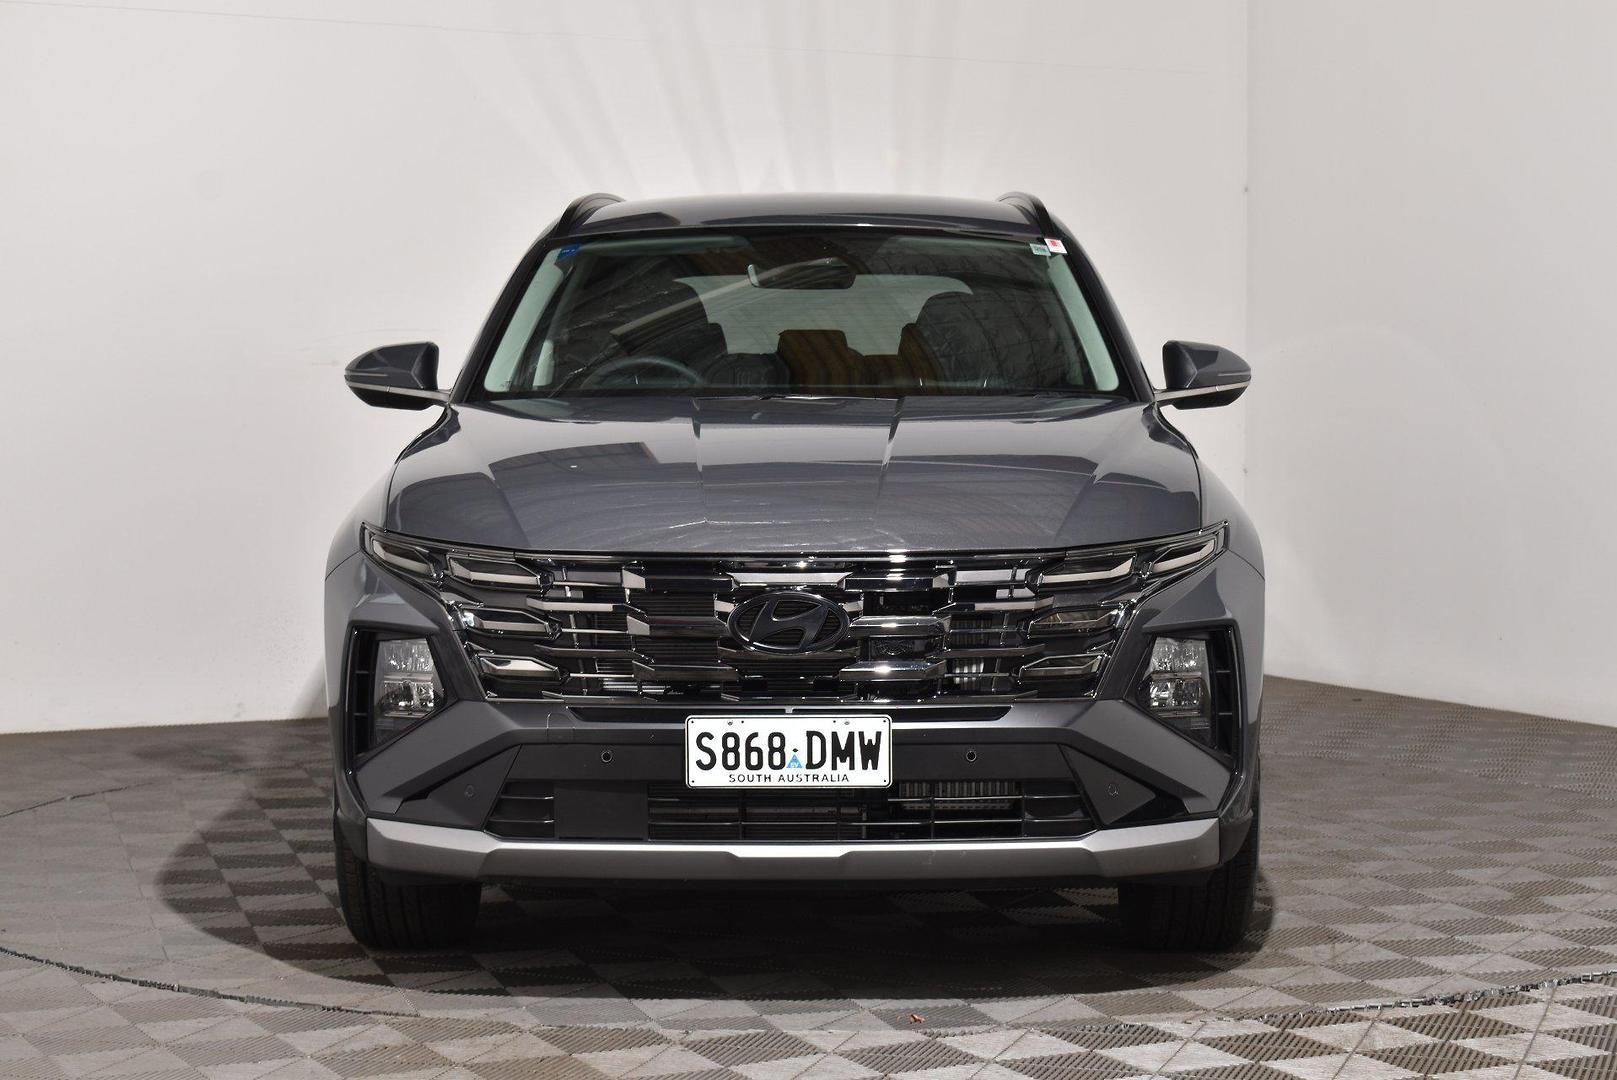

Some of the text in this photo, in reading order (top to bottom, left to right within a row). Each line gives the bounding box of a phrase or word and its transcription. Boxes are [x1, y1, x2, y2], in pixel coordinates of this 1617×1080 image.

[695, 730, 882, 771] S868 DMW
[728, 773, 849, 783] SOUTH AUSTRALIA
